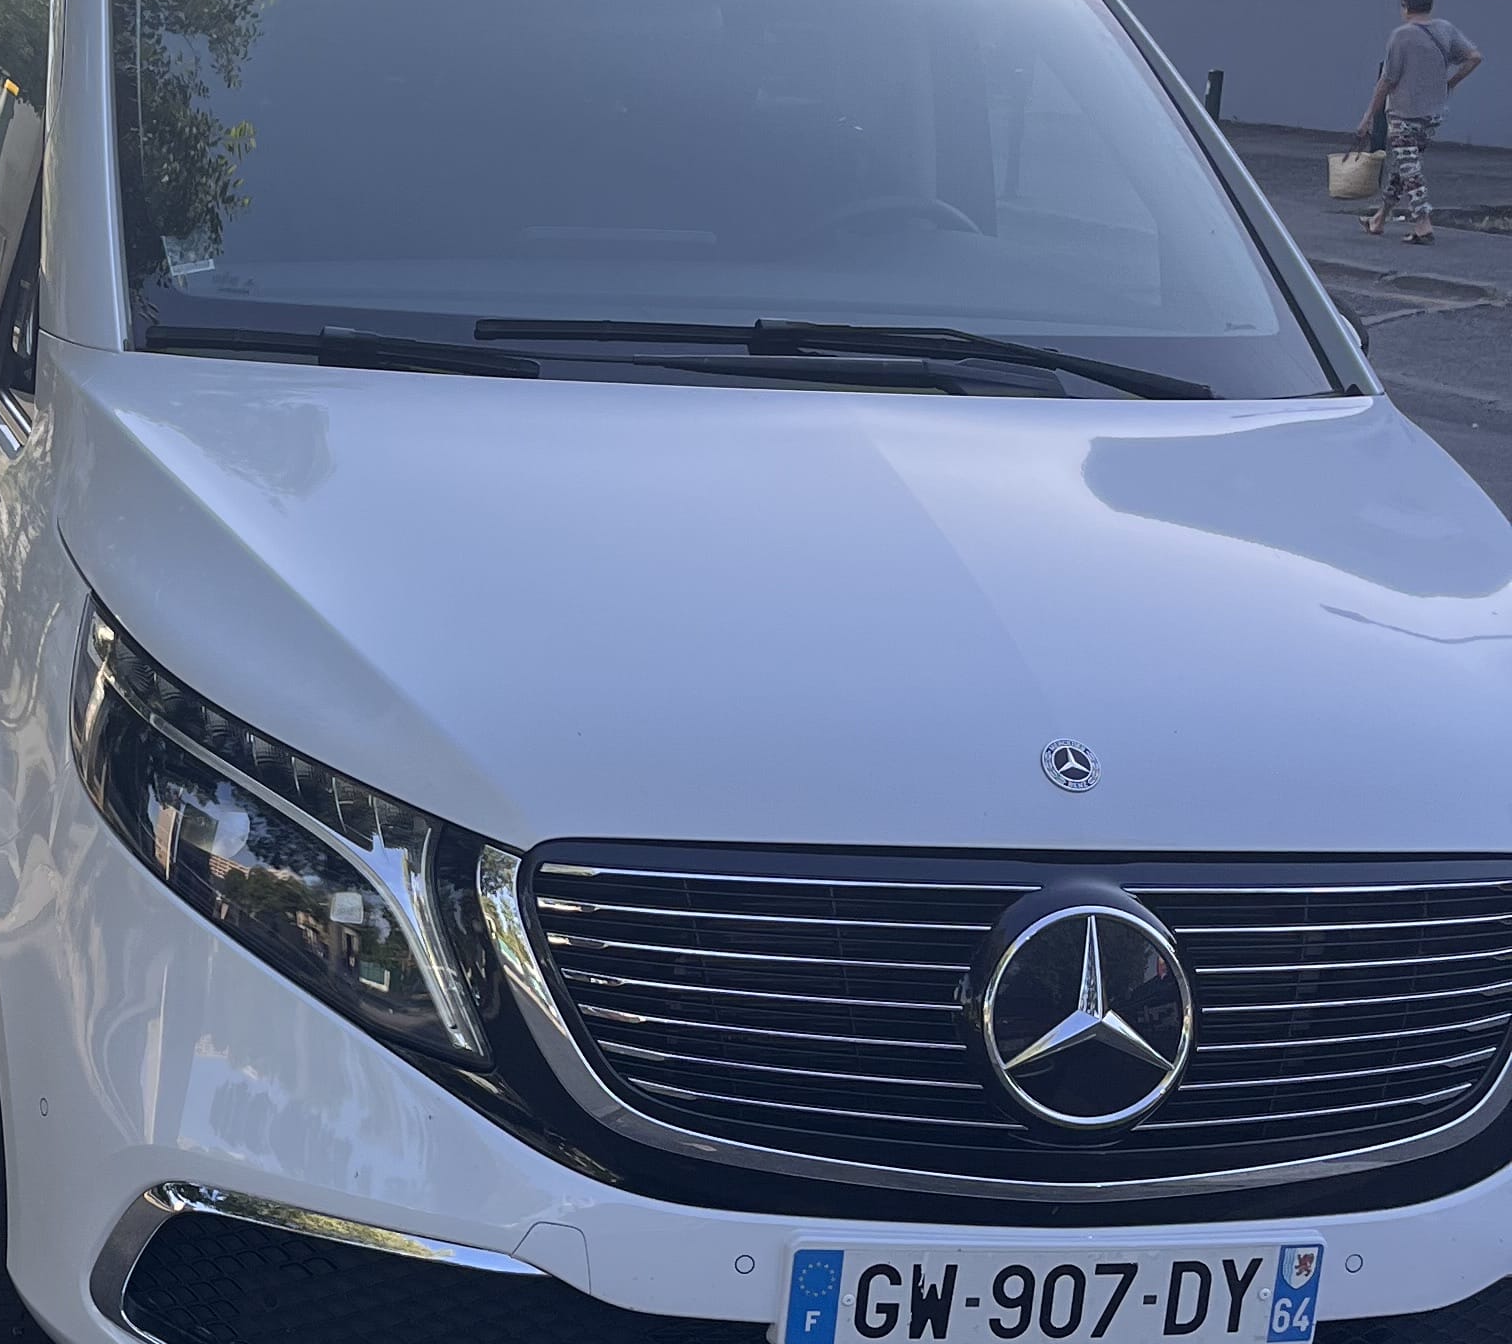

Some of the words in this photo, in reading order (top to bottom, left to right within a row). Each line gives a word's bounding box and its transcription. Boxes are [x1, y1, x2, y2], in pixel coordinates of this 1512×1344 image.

[853, 1258, 1263, 1340] GW-907-DY
[1272, 1296, 1311, 1335] 64
[804, 1309, 821, 1333] F
